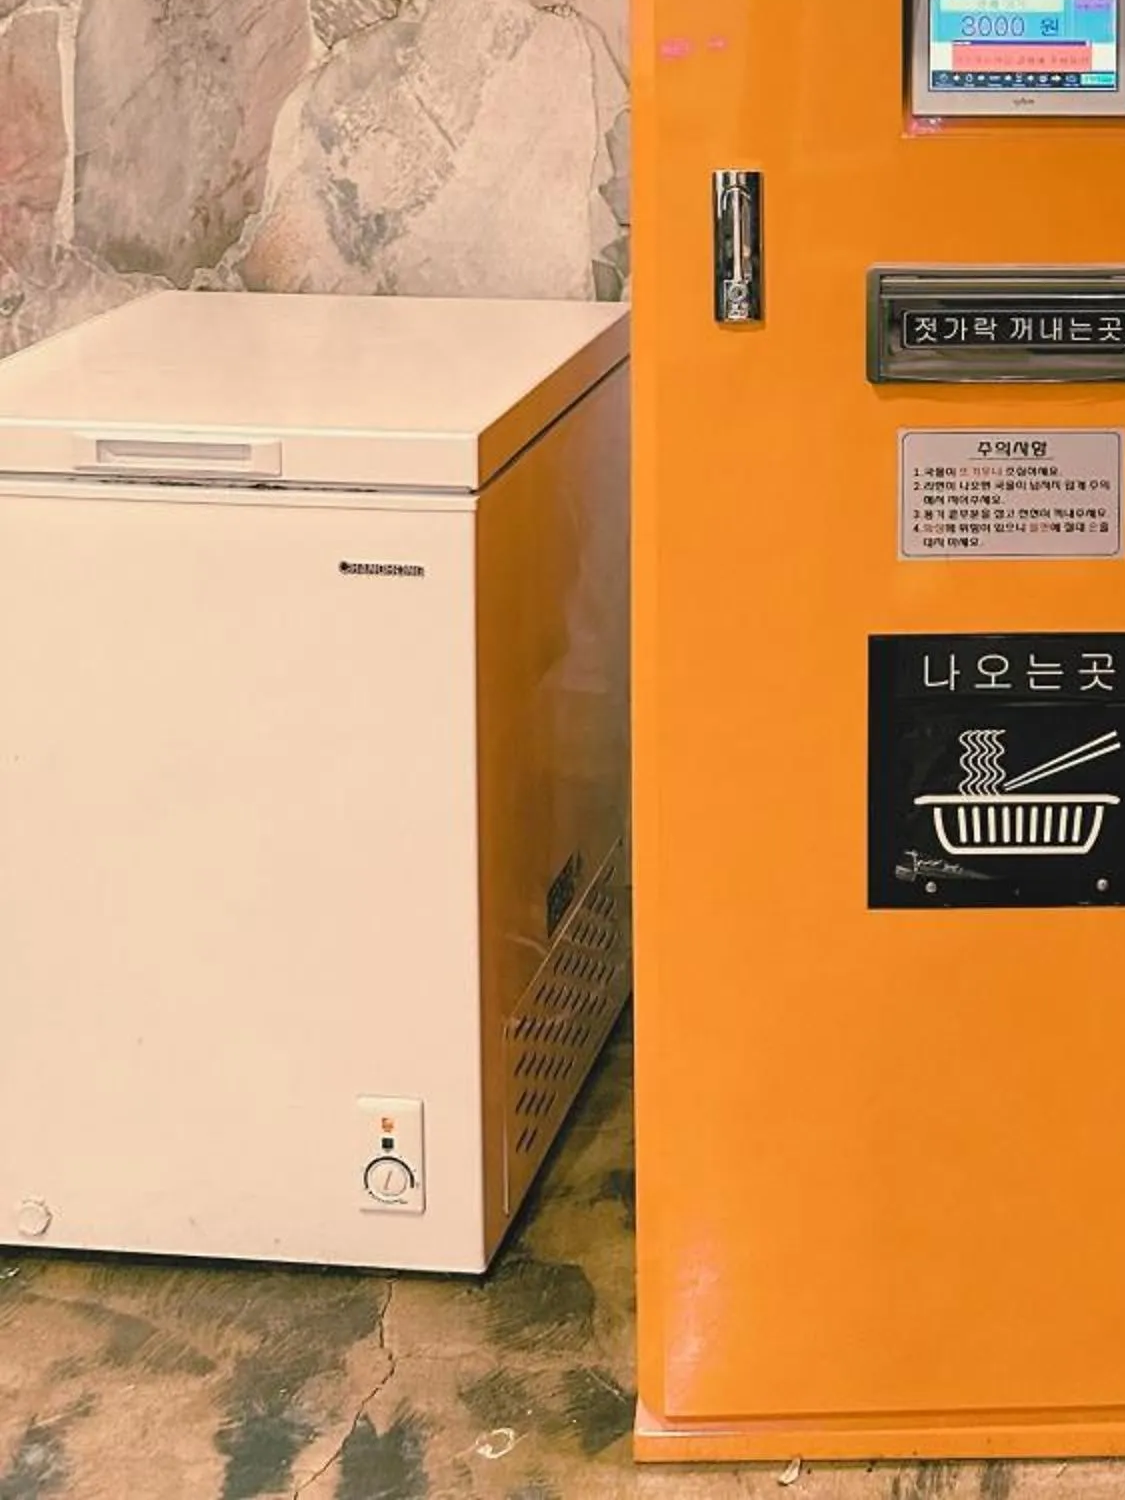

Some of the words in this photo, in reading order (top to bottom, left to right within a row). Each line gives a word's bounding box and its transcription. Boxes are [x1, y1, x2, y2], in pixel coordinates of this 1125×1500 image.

[961, 14, 1025, 38] 3000
[1040, 16, 1059, 37] 원
[914, 317, 998, 343] 젓가락
[977, 440, 1047, 457] 주의사항
